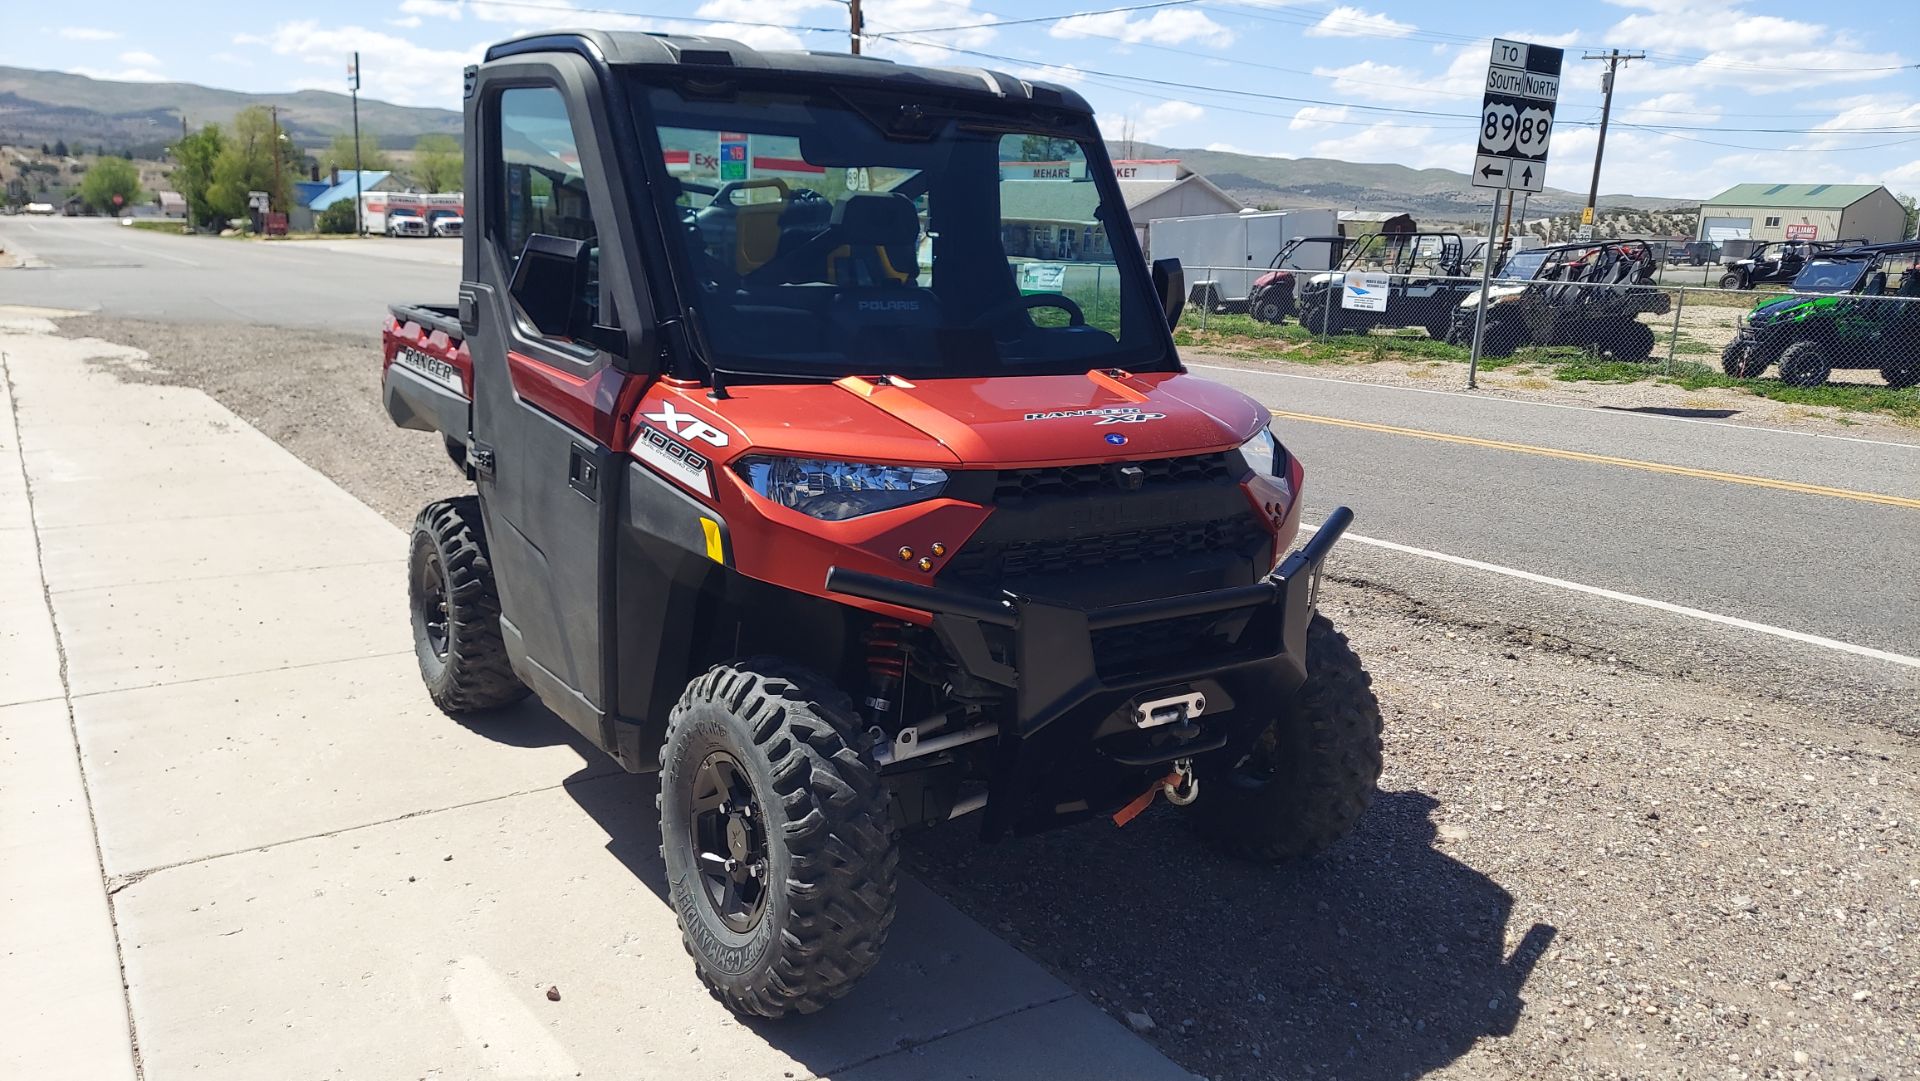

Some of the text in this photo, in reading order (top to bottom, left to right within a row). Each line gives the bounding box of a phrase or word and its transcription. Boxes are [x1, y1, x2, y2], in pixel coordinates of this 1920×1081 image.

[1502, 45, 1519, 62] TO
[1489, 71, 1521, 92] SOUTH
[1525, 77, 1557, 97] NORTH
[1484, 111, 1514, 141] 89
[1520, 117, 1549, 145] 89
[1033, 167, 1137, 179] MEHAR'S KET
[1788, 225, 1816, 234] WILLIAMS
[858, 300, 920, 311] POLARIS
[404, 346, 453, 381] RANGER
[640, 399, 730, 448] XP
[1023, 407, 1142, 421] RANGER
[1092, 412, 1167, 426] XP
[642, 426, 707, 472] 1000
[675, 882, 743, 971] COMMANDER
